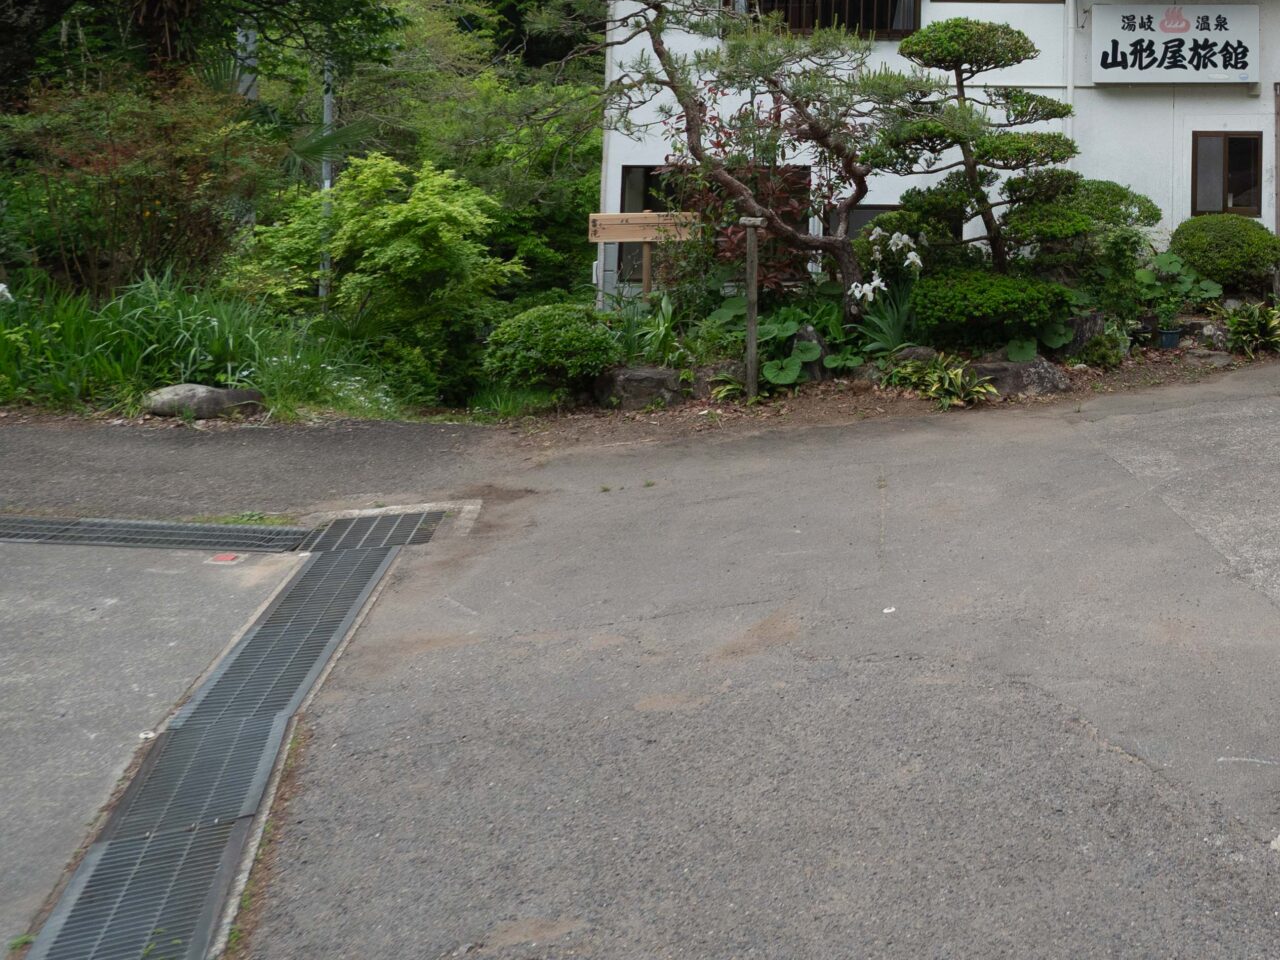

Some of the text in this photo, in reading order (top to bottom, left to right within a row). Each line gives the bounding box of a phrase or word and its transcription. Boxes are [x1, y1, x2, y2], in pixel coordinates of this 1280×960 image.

[1121, 14, 1230, 33] 湯岐 温泉
[1100, 38, 1250, 70] 山形屋旅館
